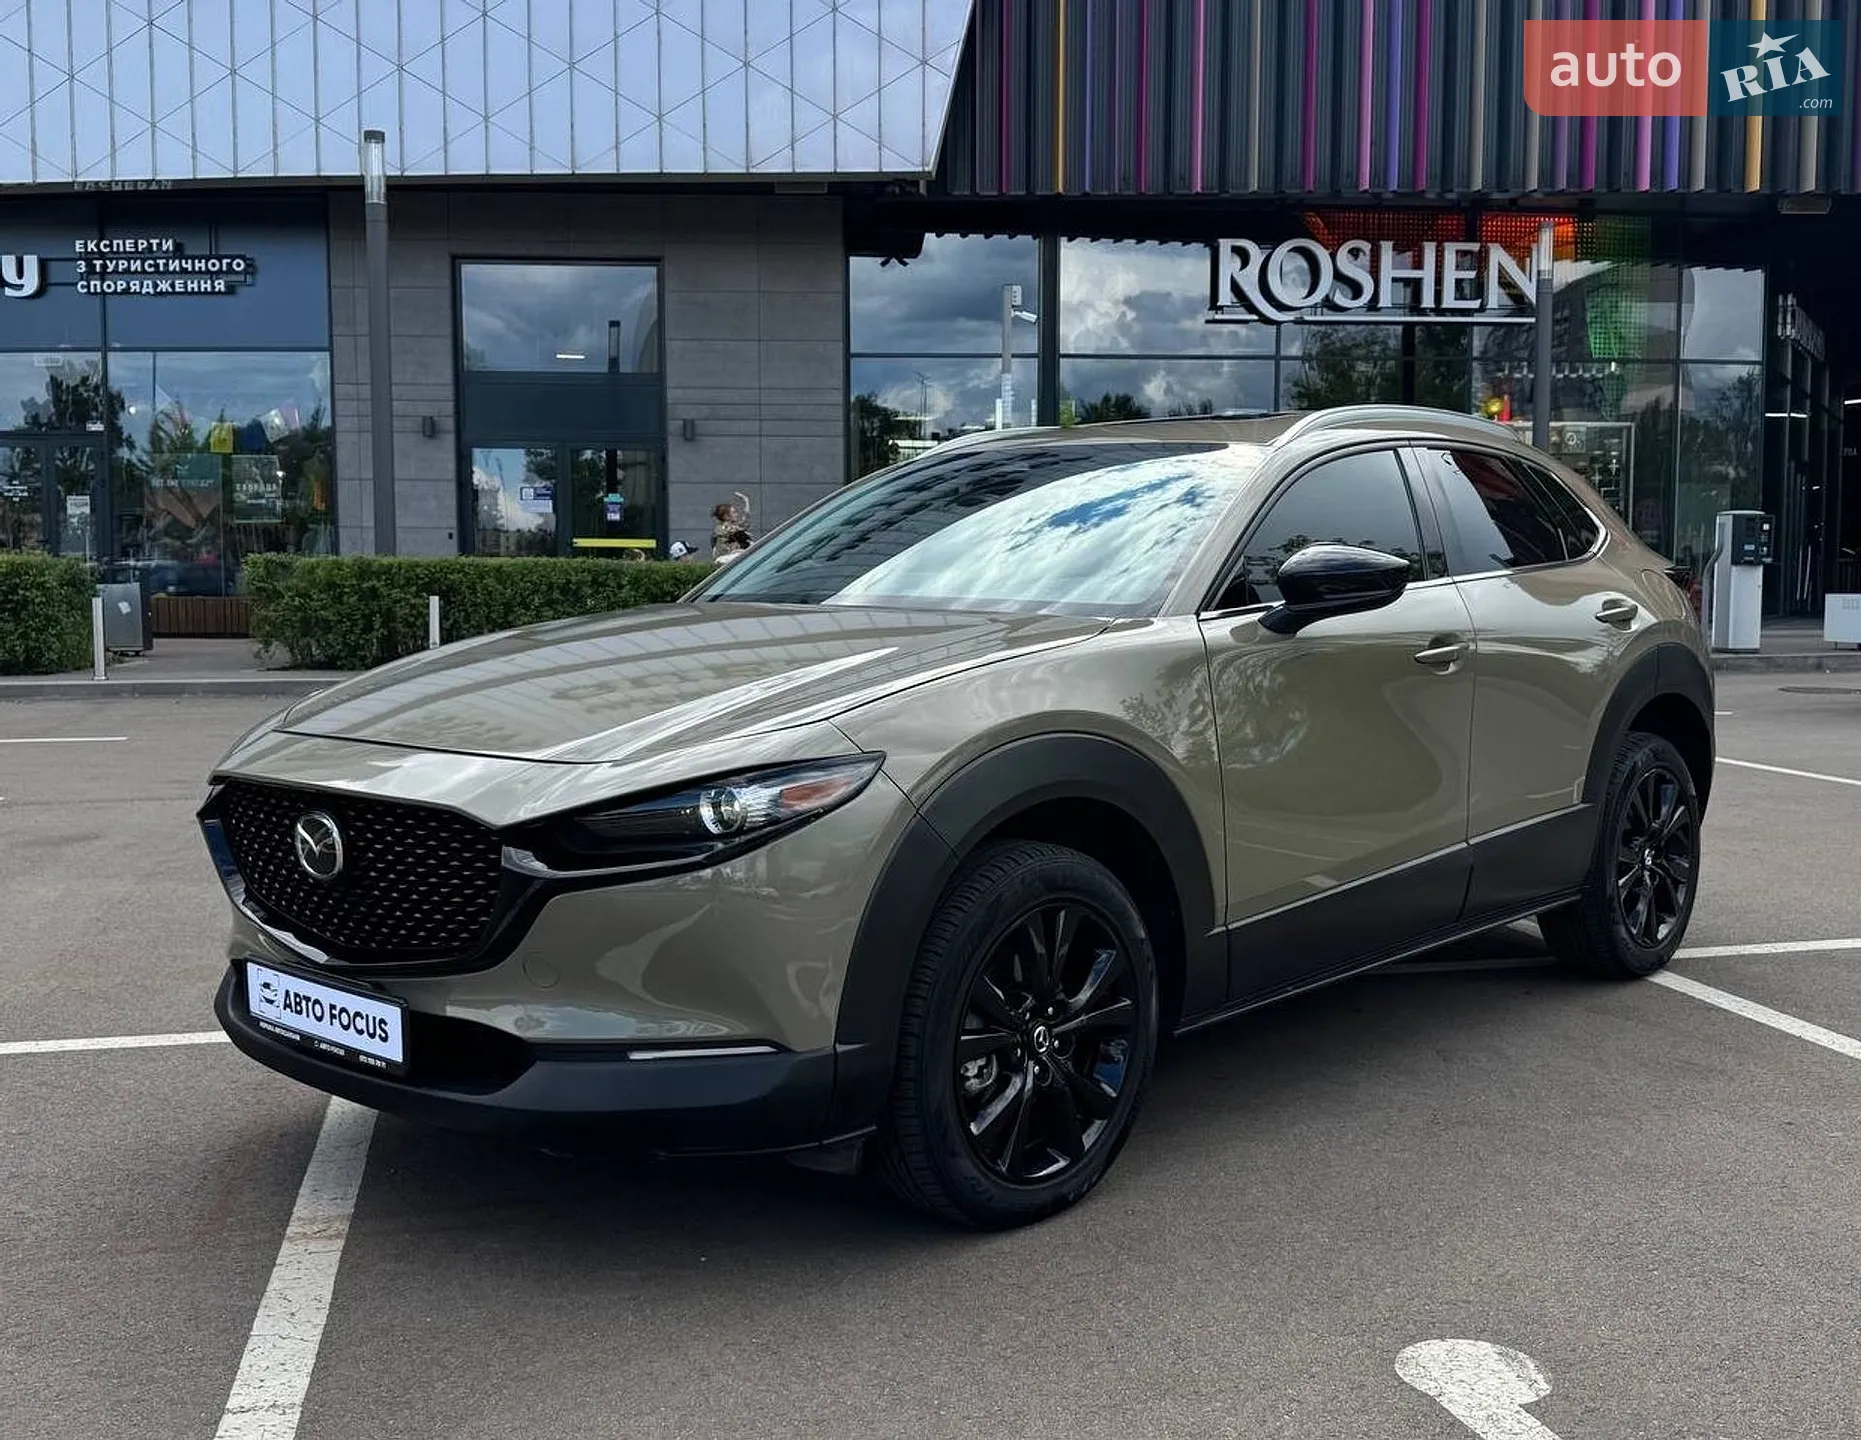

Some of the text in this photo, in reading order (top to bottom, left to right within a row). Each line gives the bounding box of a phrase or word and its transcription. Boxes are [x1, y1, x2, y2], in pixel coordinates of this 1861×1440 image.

[75, 238, 174, 252] ЕКСПЕРТИ
[93, 258, 246, 273] ТУРИСТИЧНОГО
[76, 279, 226, 294] СПОРЯДЖЕННЯ
[1217, 238, 1537, 322] ROSHEN
[329, 1003, 389, 1043] FOCUS
